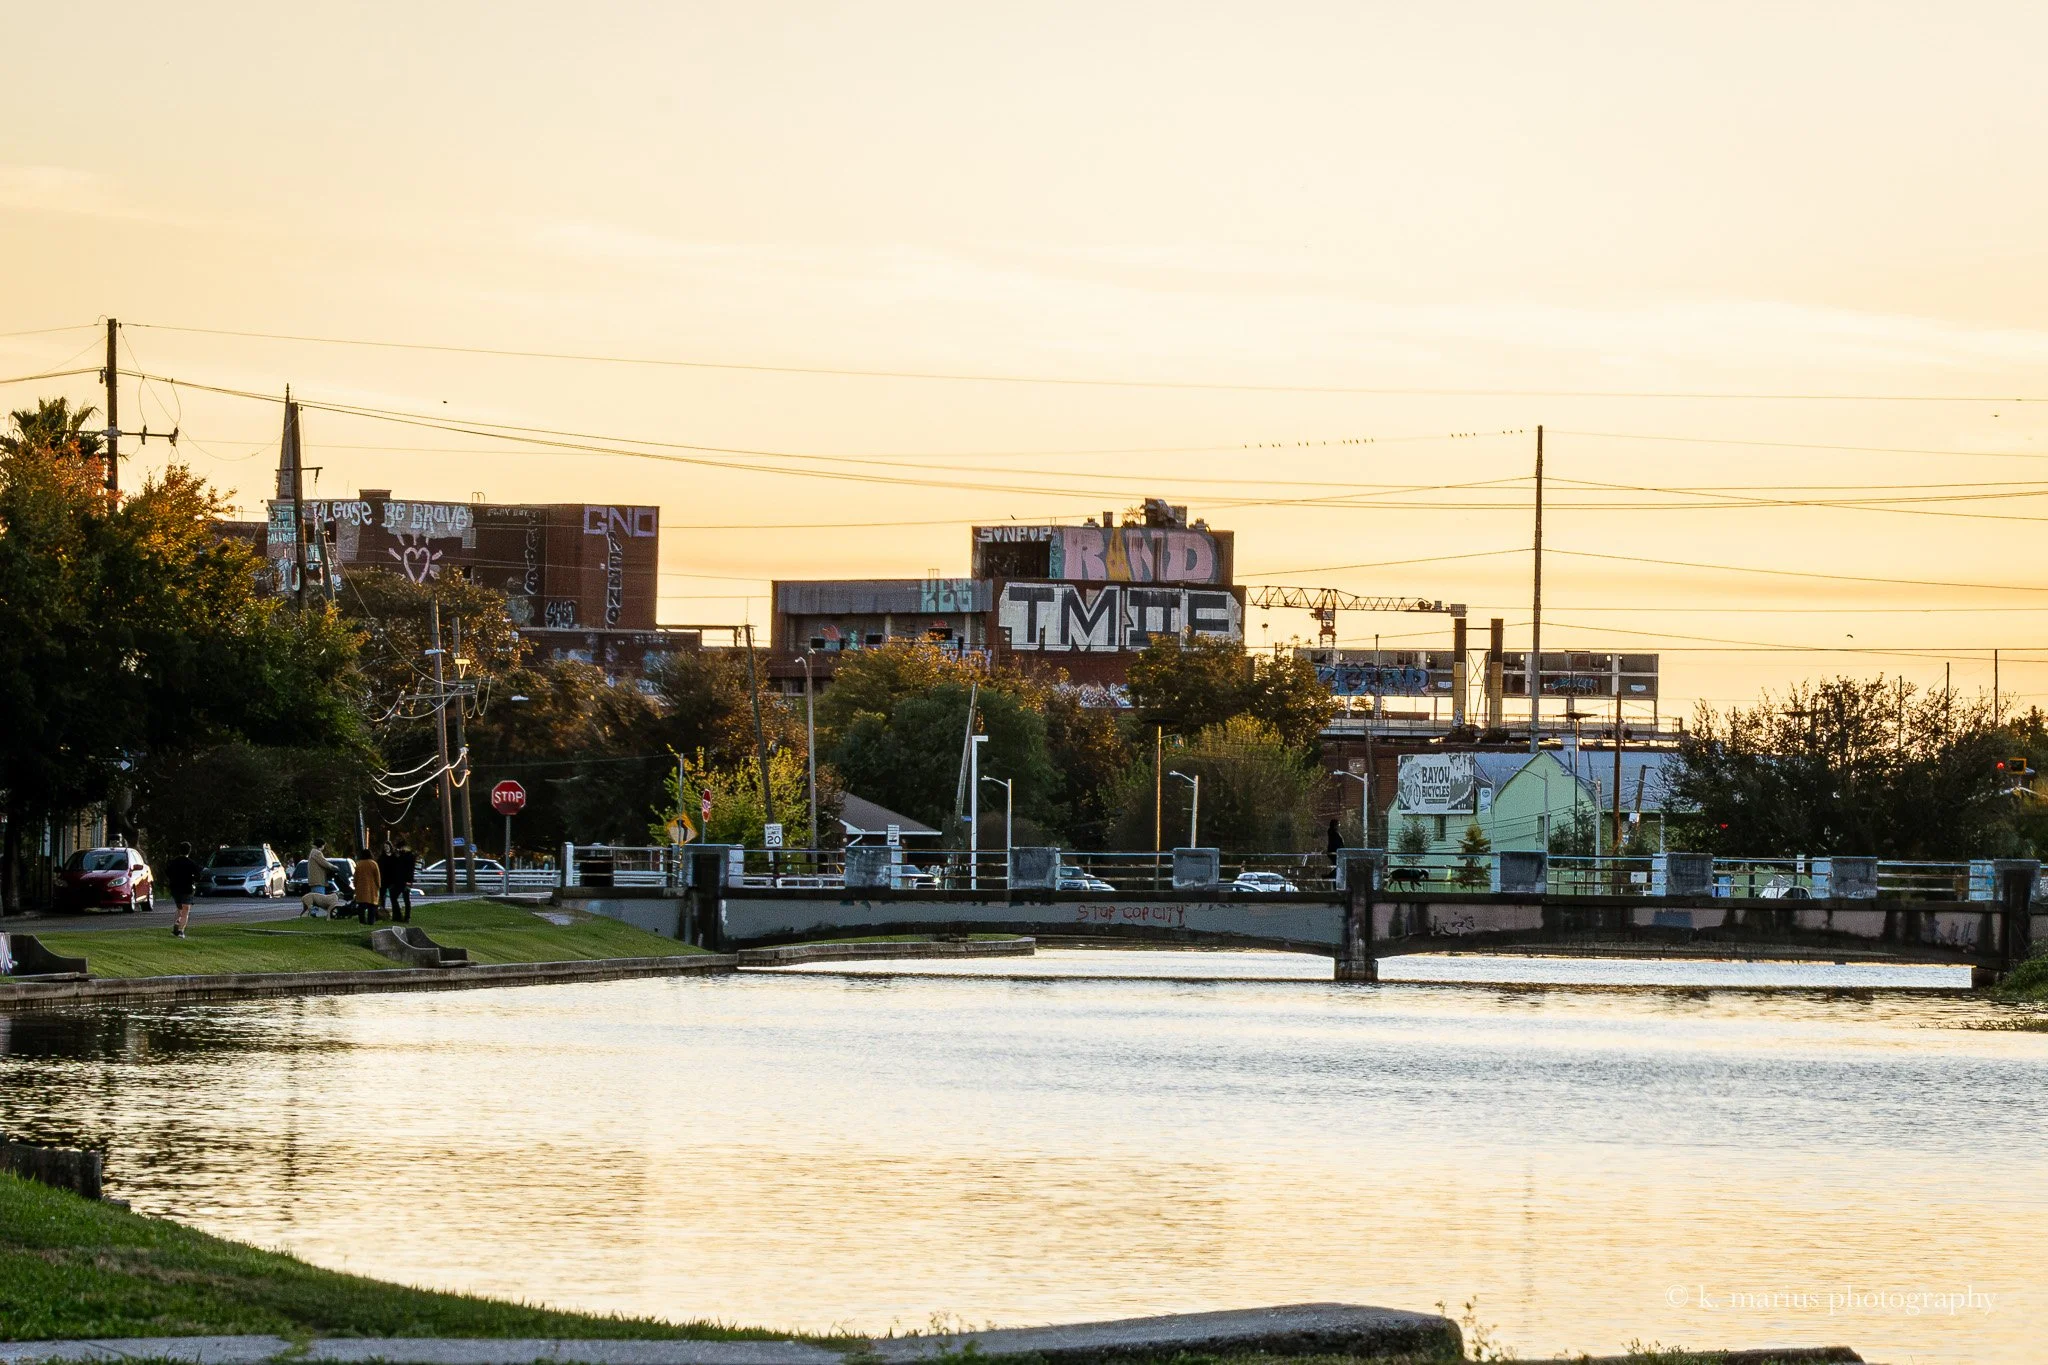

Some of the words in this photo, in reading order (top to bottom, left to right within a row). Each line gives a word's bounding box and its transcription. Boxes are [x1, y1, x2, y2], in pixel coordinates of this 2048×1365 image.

[1422, 766, 1450, 784] BAYOU
[494, 790, 523, 804] STOP
[1422, 786, 1450, 798] BICYCLES
[767, 835, 781, 845] 20
[1076, 904, 1116, 921] STOP
[1122, 906, 1150, 921] COP
[1152, 904, 1186, 928] CITY
